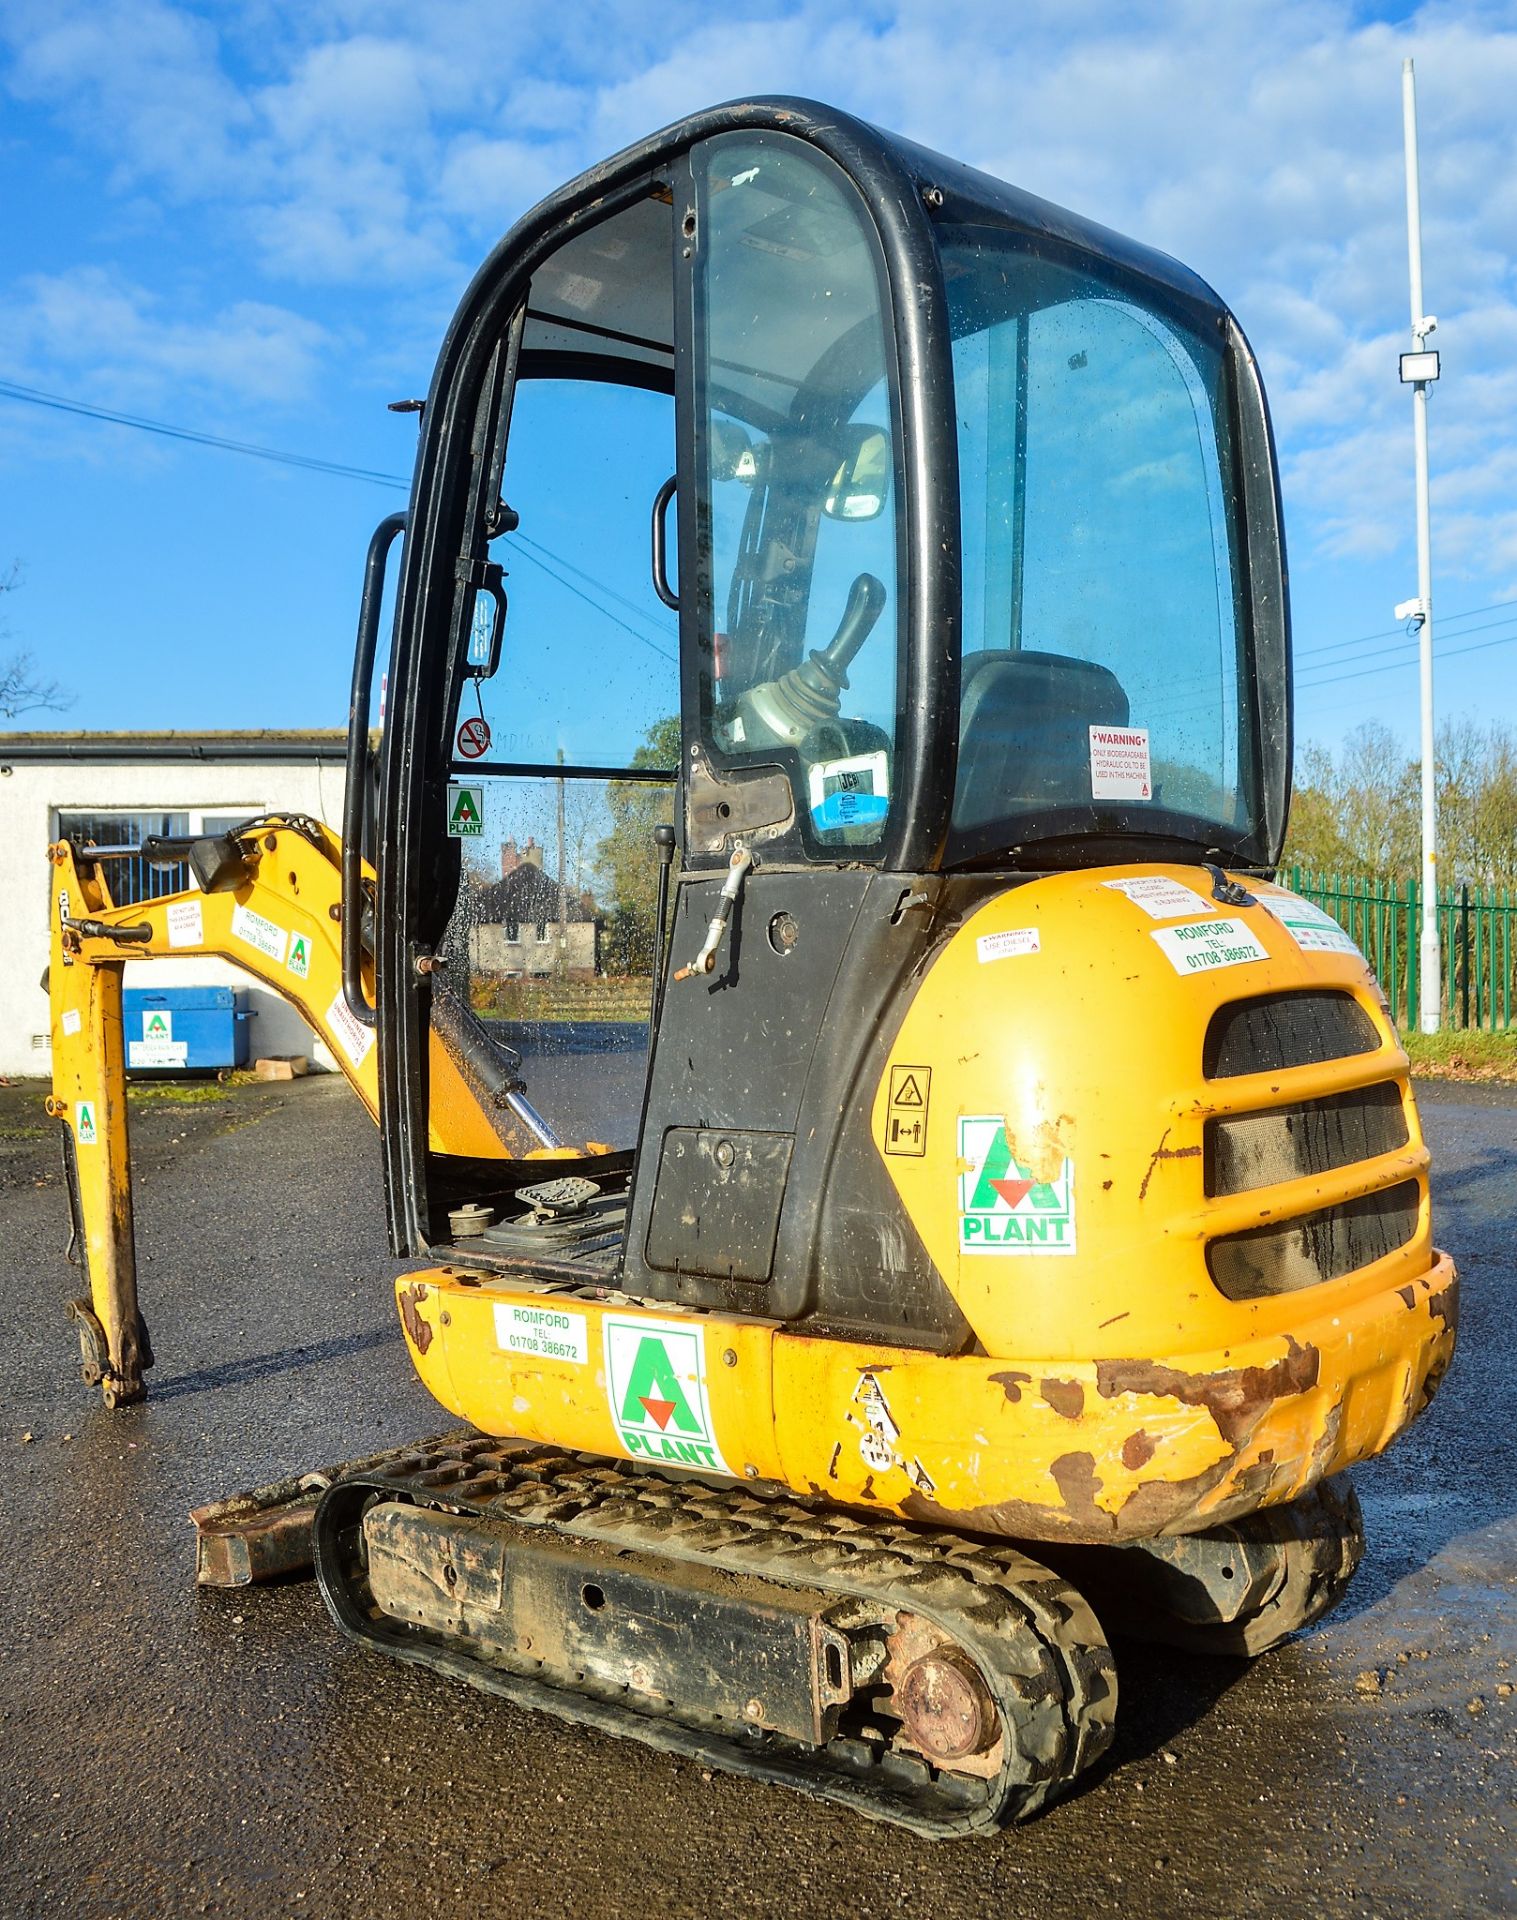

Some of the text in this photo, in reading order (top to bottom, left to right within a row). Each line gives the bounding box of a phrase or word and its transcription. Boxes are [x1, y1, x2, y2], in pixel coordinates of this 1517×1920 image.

[1097, 733, 1142, 746] WARNING
[841, 773, 859, 790] JCB
[1096, 770, 1108, 778] USED
[1125, 772, 1147, 780] MACHINE
[452, 791, 481, 821] A
[449, 824, 482, 834] PLANT
[988, 930, 1027, 941] WARNING
[1174, 922, 1234, 941] ROMFORD
[292, 939, 306, 966] A
[1186, 945, 1260, 969] 01708 386672
[288, 959, 307, 975] PLANT
[148, 1014, 167, 1032] A
[80, 1105, 94, 1130] A
[969, 1126, 1062, 1209] A
[963, 1217, 1070, 1241] PLANT
[513, 1309, 570, 1329] ROMFORD
[509, 1334, 578, 1359] 01708 386672
[621, 1336, 704, 1434] A
[621, 1431, 719, 1468] PLANT
